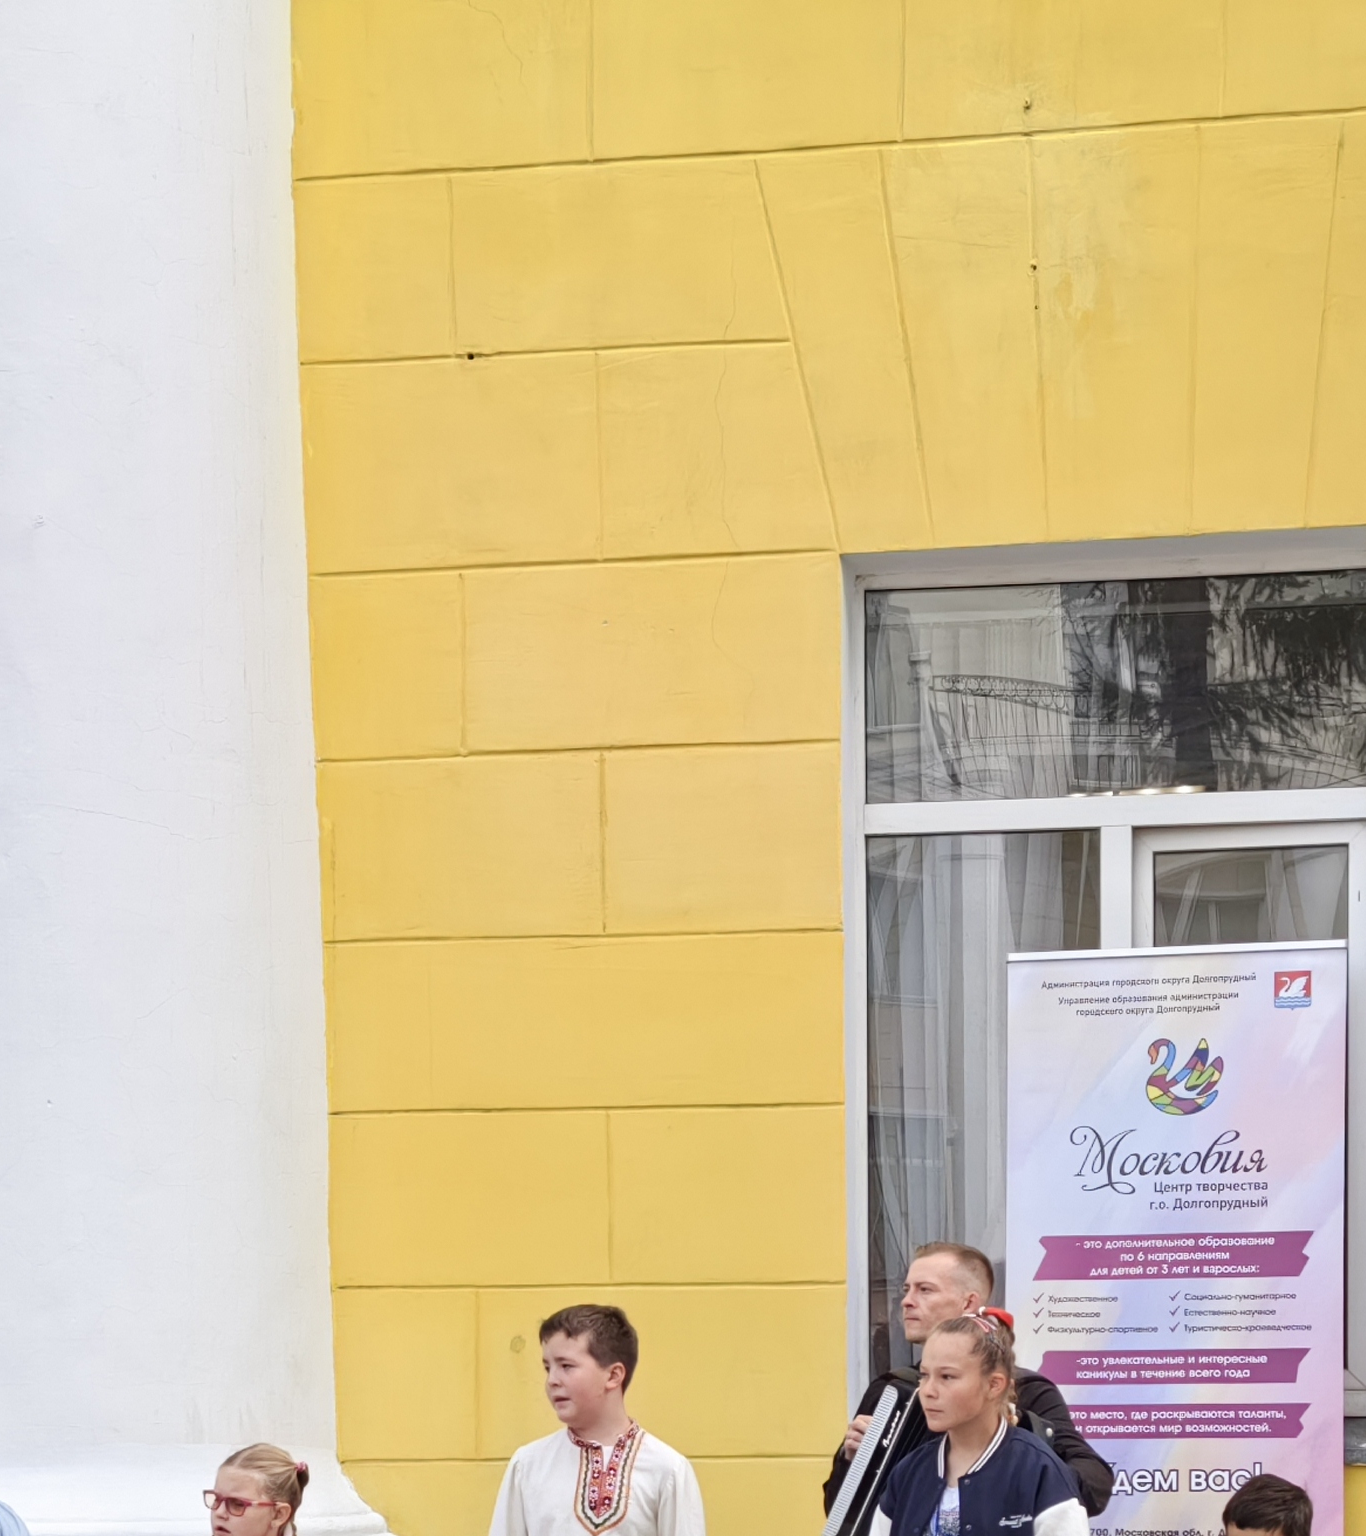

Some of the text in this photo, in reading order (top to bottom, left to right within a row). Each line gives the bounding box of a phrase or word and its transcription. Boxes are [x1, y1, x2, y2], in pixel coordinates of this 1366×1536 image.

[1041, 972, 1257, 990] Администрация городского округа Долгопрудный
[1058, 992, 1239, 1006] Управление образования администрации
[1076, 1003, 1220, 1017] городского округа Долгопрудный
[1070, 1125, 1268, 1195] Московия
[1153, 1181, 1268, 1194] Центр творчества
[1149, 1196, 1268, 1211] г.о. Долгопрудный
[1083, 1240, 1102, 1249] это
[1105, 1238, 1195, 1250] дополнительное
[1198, 1236, 1275, 1249] образование
[1120, 1251, 1230, 1262] по 6 направлениям
[1089, 1264, 1261, 1276] для детей от 3 лет и взрослых:
[1048, 1295, 1118, 1304] Художественное
[1184, 1293, 1297, 1302] Социально-гуманитарное
[1048, 1310, 1101, 1318] Техническое
[1184, 1308, 1276, 1318] Естественно-научное
[1048, 1326, 1159, 1334] Физкультурно-спортивное
[1102, 1355, 1185, 1367] увлекательные
[1188, 1356, 1195, 1364] и
[1198, 1354, 1268, 1365] интересные
[1076, 1369, 1250, 1380] каникулы в течение всего года
[1090, 1411, 1127, 1420] место,
[1131, 1411, 1148, 1420] где
[1151, 1409, 1235, 1421] раскрываются
[1238, 1409, 1286, 1420] таланты,
[1085, 1425, 1156, 1435] открывается
[1159, 1424, 1182, 1434] мир
[1185, 1422, 1272, 1433] возможностей.
[1107, 1462, 1179, 1496] дем
[1115, 1528, 1179, 1536] Московская
[1182, 1528, 1204, 1536] обл.
